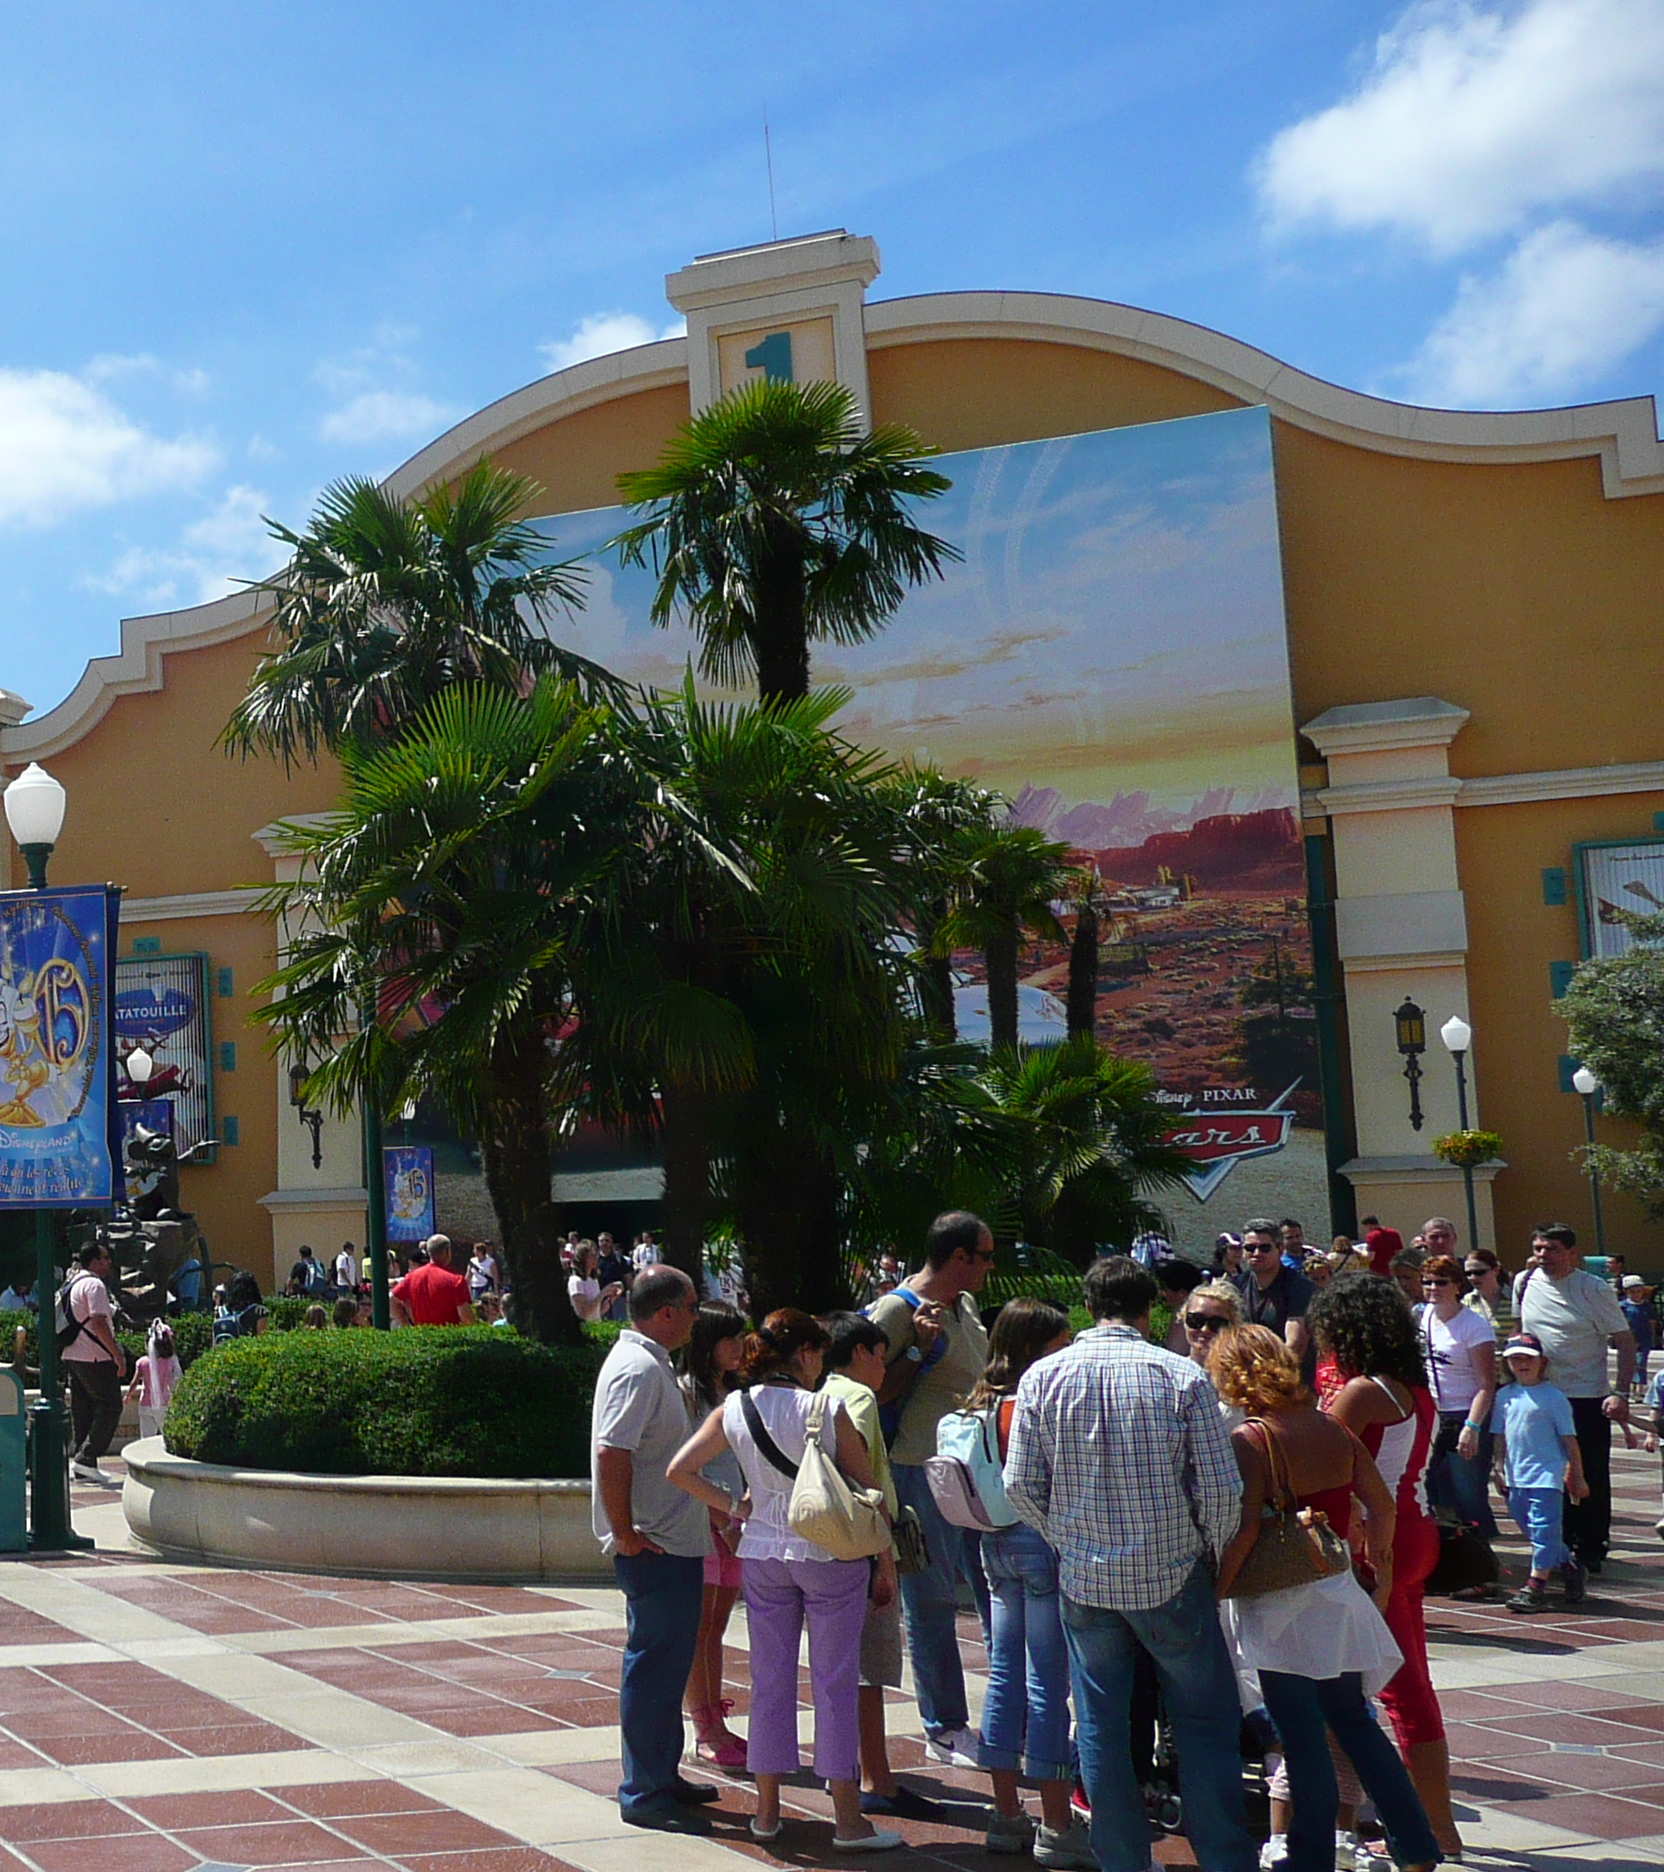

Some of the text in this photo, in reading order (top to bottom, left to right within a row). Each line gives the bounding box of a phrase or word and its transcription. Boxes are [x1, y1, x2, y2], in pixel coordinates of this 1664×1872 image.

[745, 331, 793, 384] 1
[116, 1005, 187, 1019] TATOUILLE
[1202, 1088, 1257, 1101] PIXAR
[1172, 1126, 1267, 1146] ars
